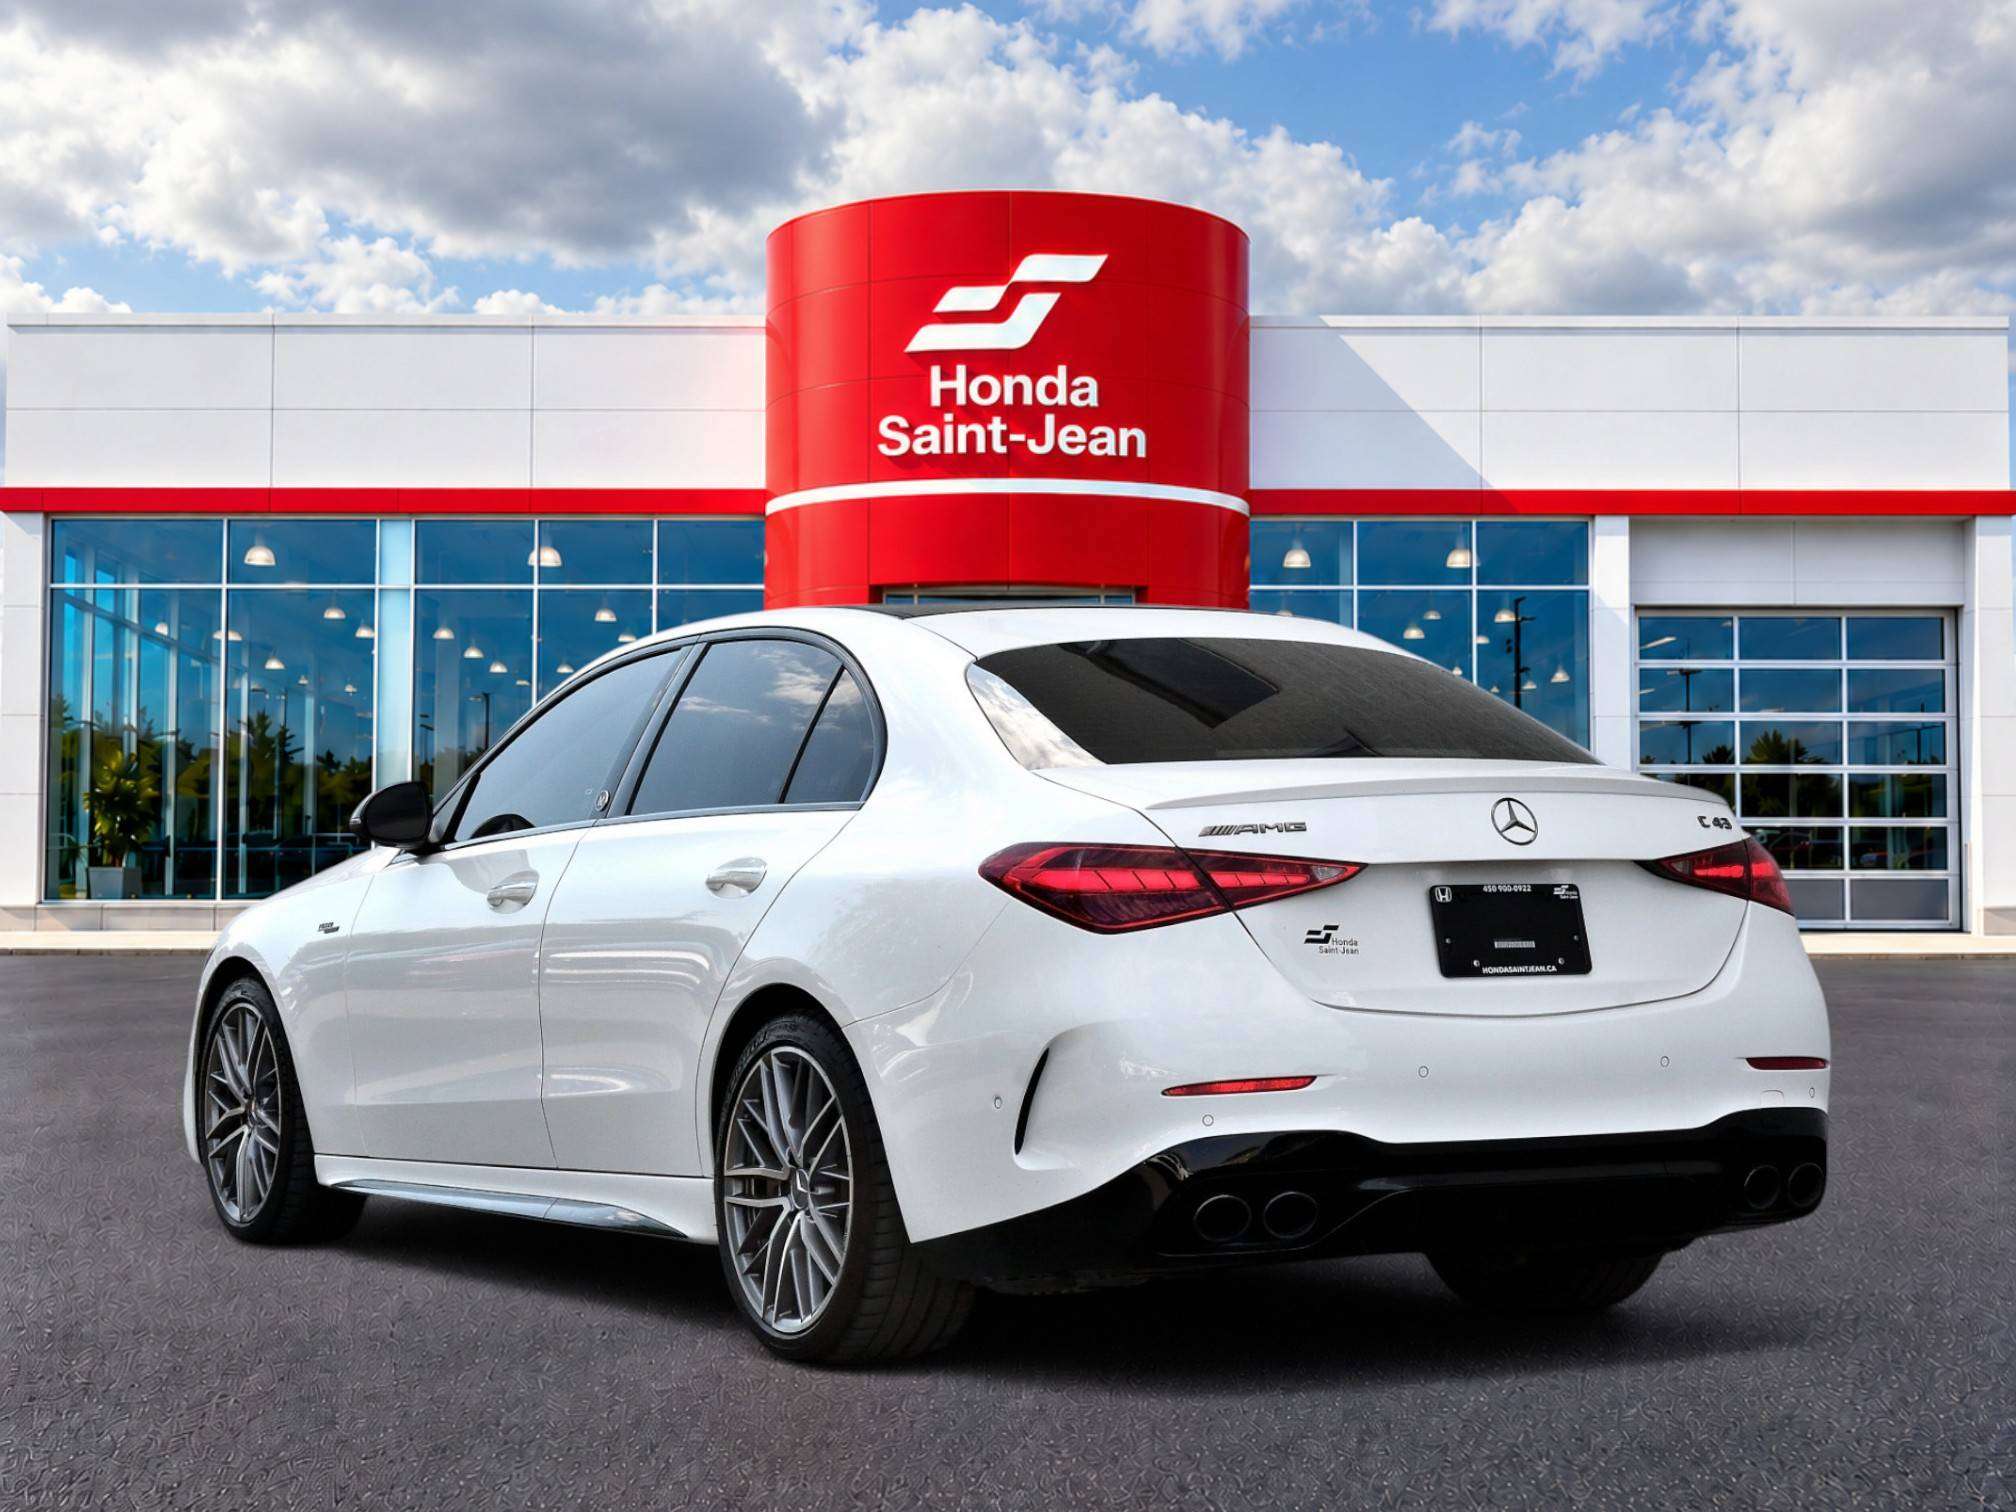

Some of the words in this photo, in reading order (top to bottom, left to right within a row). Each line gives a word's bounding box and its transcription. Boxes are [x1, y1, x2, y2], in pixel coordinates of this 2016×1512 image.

[929, 364, 1099, 408] Honda
[877, 413, 1147, 458] Saint-Jean
[1233, 821, 1307, 835] AMG
[1331, 938, 1358, 946] Honda
[1482, 965, 1557, 974] HONDASAINTJEAN.CA
